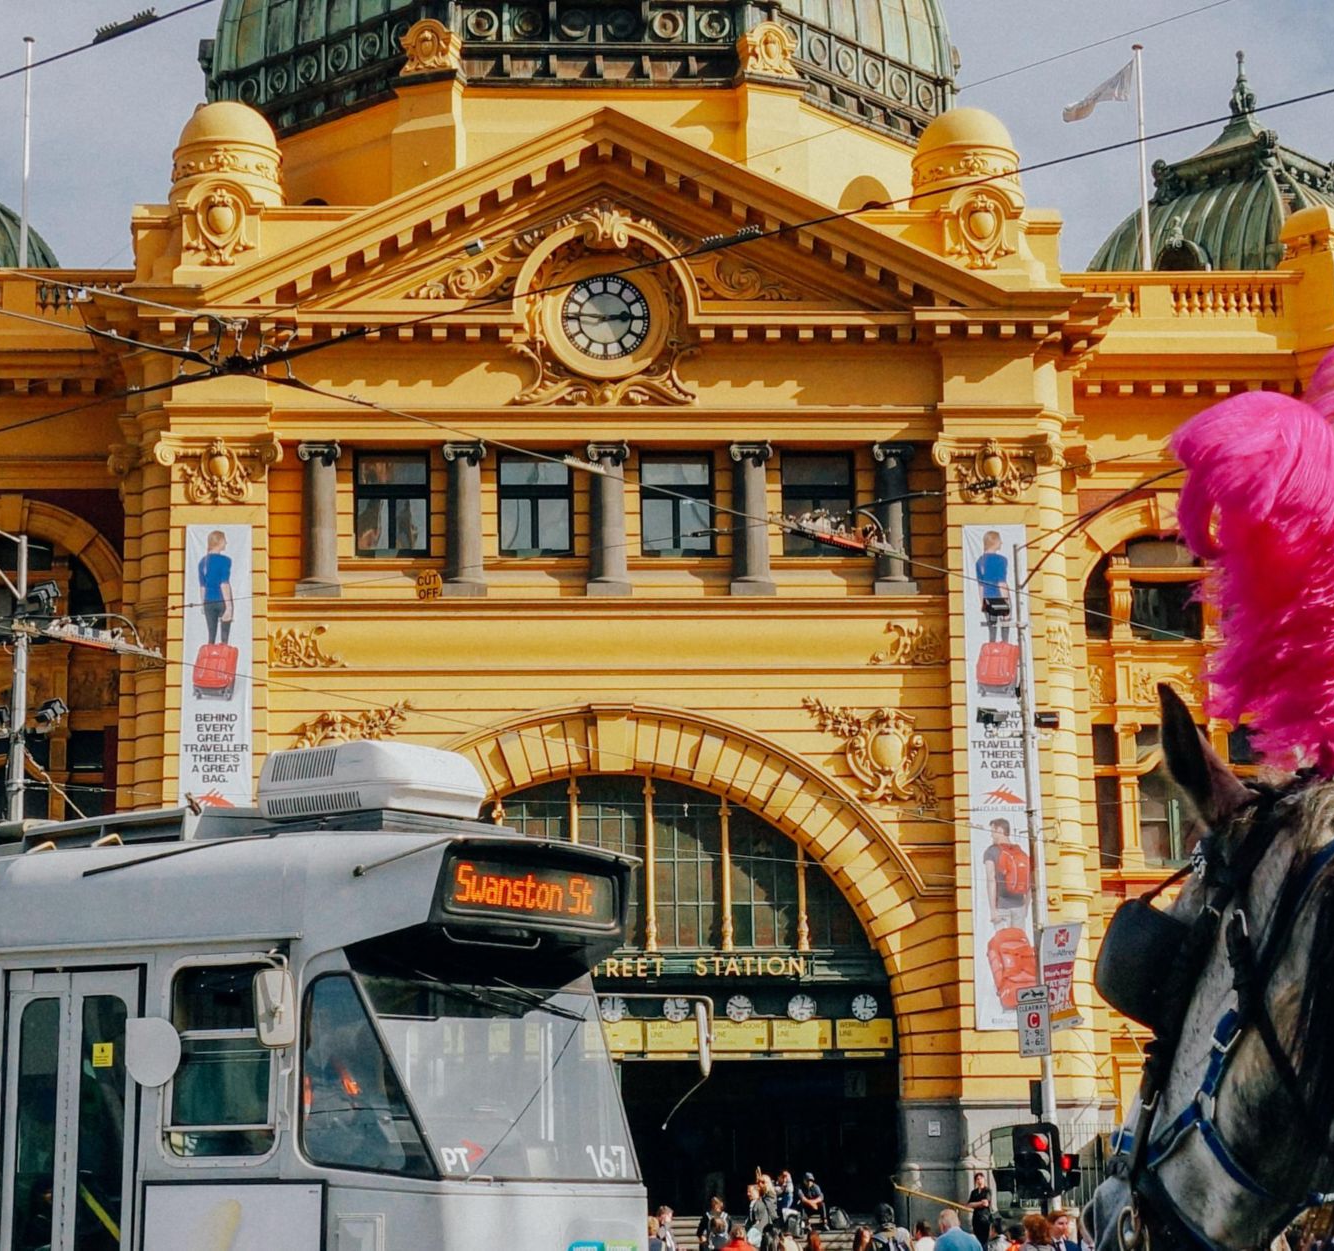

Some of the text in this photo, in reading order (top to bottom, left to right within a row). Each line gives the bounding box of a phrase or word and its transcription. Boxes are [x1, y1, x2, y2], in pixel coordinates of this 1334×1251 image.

[418, 575, 437, 587] CUT
[419, 588, 439, 600] OFF
[195, 713, 238, 723] BEHIND
[197, 723, 235, 733] EVERY
[984, 721, 1020, 729] ERY
[197, 733, 235, 743] GREAT
[183, 743, 249, 753] TRAVELLER
[192, 753, 240, 763] THERE'S
[191, 764, 240, 773] A GREAT
[980, 761, 988, 769] A
[202, 774, 229, 783] BAG.
[991, 770, 1017, 779] BAG.
[455, 863, 594, 915] Swanston St
[695, 956, 805, 977] STATION
[1029, 1012, 1039, 1028] C
[585, 1145, 627, 1178] 167
